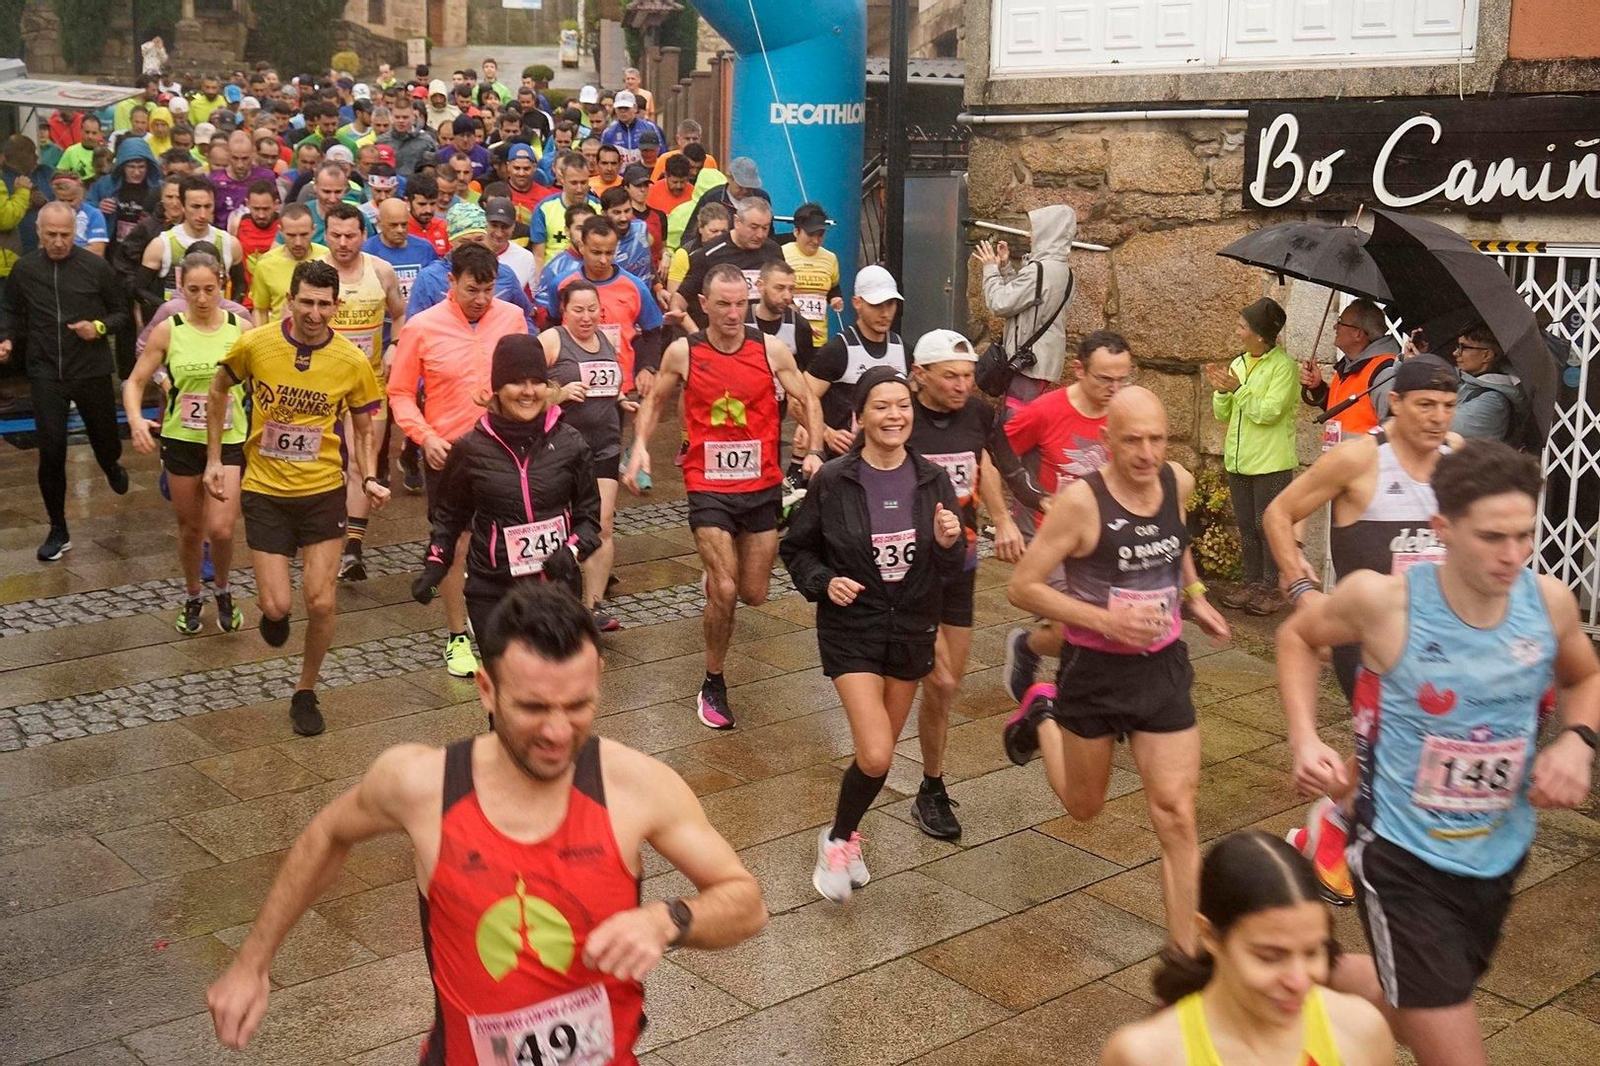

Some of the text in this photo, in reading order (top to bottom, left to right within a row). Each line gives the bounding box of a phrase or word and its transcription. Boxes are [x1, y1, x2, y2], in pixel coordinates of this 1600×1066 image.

[1250, 113, 1345, 207] Bo
[799, 300, 822, 312] 244
[589, 369, 616, 386] 237
[276, 384, 328, 402] TANINOS
[278, 433, 306, 452] 64
[715, 450, 752, 468] 107
[519, 530, 561, 559] 245
[871, 541, 917, 568] 236
[1440, 757, 1511, 792] 148
[516, 1023, 578, 1066] 49
